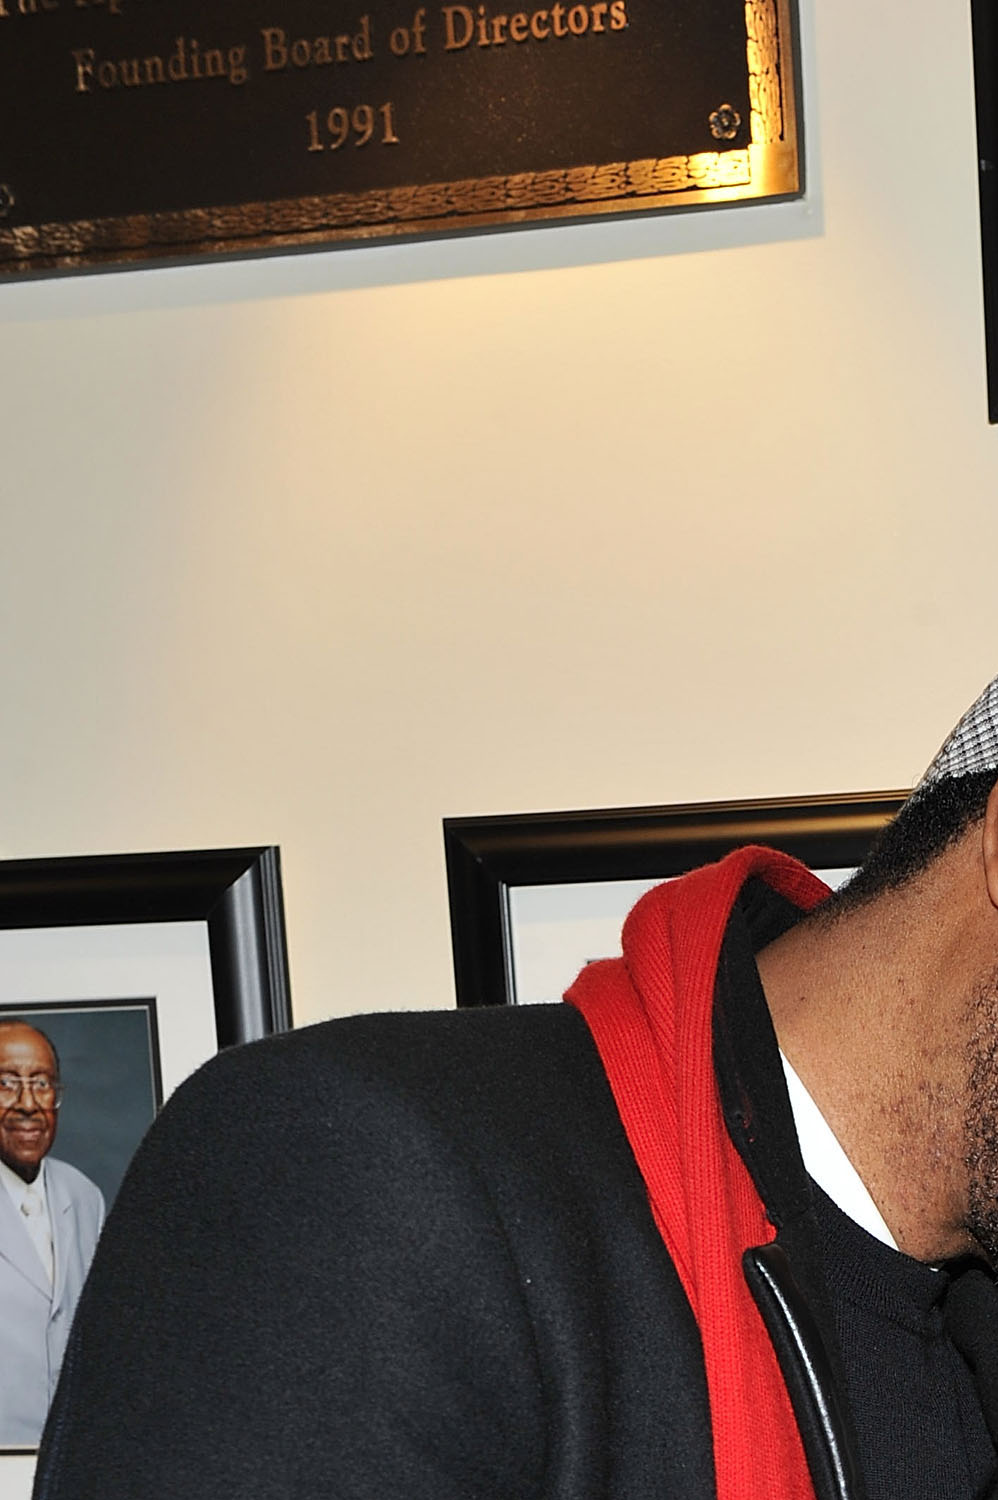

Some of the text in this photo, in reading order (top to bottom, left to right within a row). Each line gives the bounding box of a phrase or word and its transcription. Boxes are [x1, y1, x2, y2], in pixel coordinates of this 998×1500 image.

[72, 0, 629, 92] Founding Board of Directors
[305, 102, 400, 152] 1991
